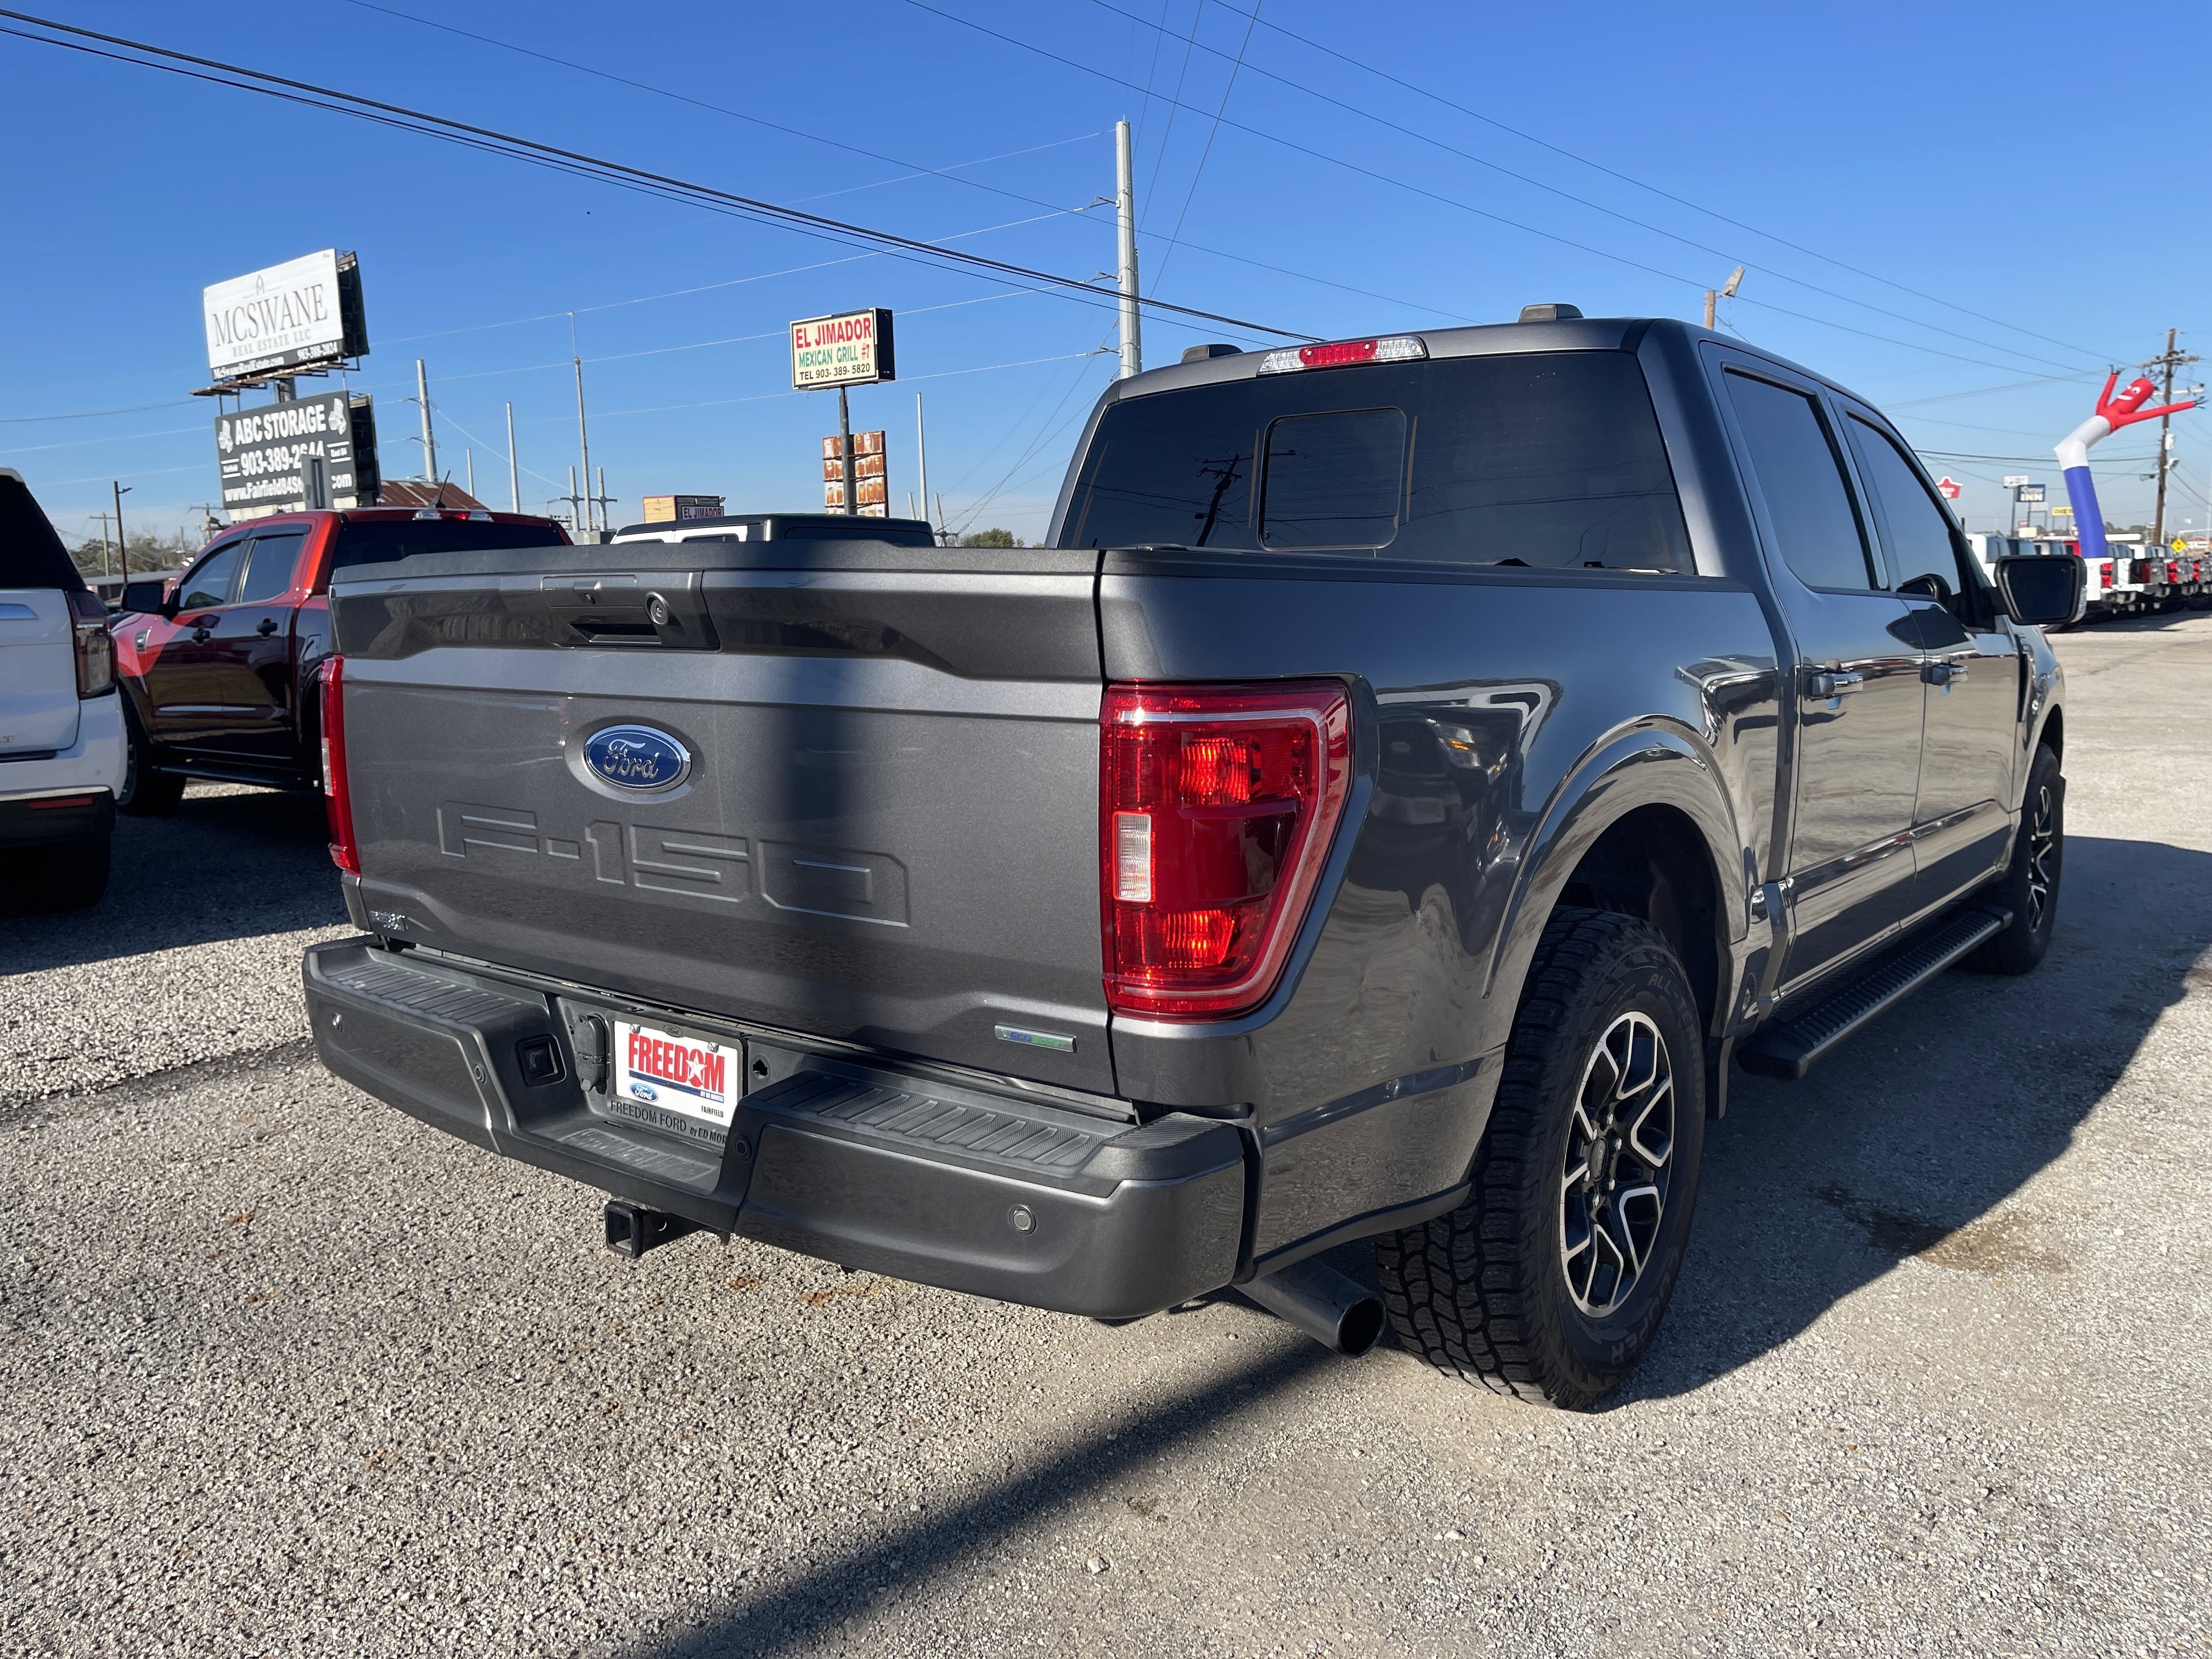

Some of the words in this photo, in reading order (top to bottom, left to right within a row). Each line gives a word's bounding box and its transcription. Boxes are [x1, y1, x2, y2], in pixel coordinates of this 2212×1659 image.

[212, 284, 328, 347] MCSWANE
[233, 343, 253, 357] REAL
[258, 334, 290, 352] ESTATE
[295, 329, 312, 343] LLC
[796, 328, 811, 348] EL
[815, 317, 872, 346] JIMADOR
[799, 348, 833, 368] MEXICAN
[837, 345, 858, 363] GRILL
[800, 371, 814, 380] TEL
[816, 368, 832, 379] 903-
[833, 366, 850, 376] 389-
[852, 363, 870, 374] 5820
[235, 416, 263, 445] ABC
[264, 404, 327, 440] STORAGE
[684, 507, 691, 518] EL
[693, 507, 721, 518] JIMADOR
[604, 739, 659, 778] Ford
[438, 800, 911, 927] F-150
[629, 1032, 725, 1093] FREEDOM
[634, 1085, 653, 1101] Ford
[611, 1099, 657, 1124] FREEDOM
[660, 1114, 686, 1132] FORD
[698, 1127, 708, 1139] ED
[709, 1131, 727, 1144] MOR
[701, 1105, 724, 1118] FAIRFIELD
